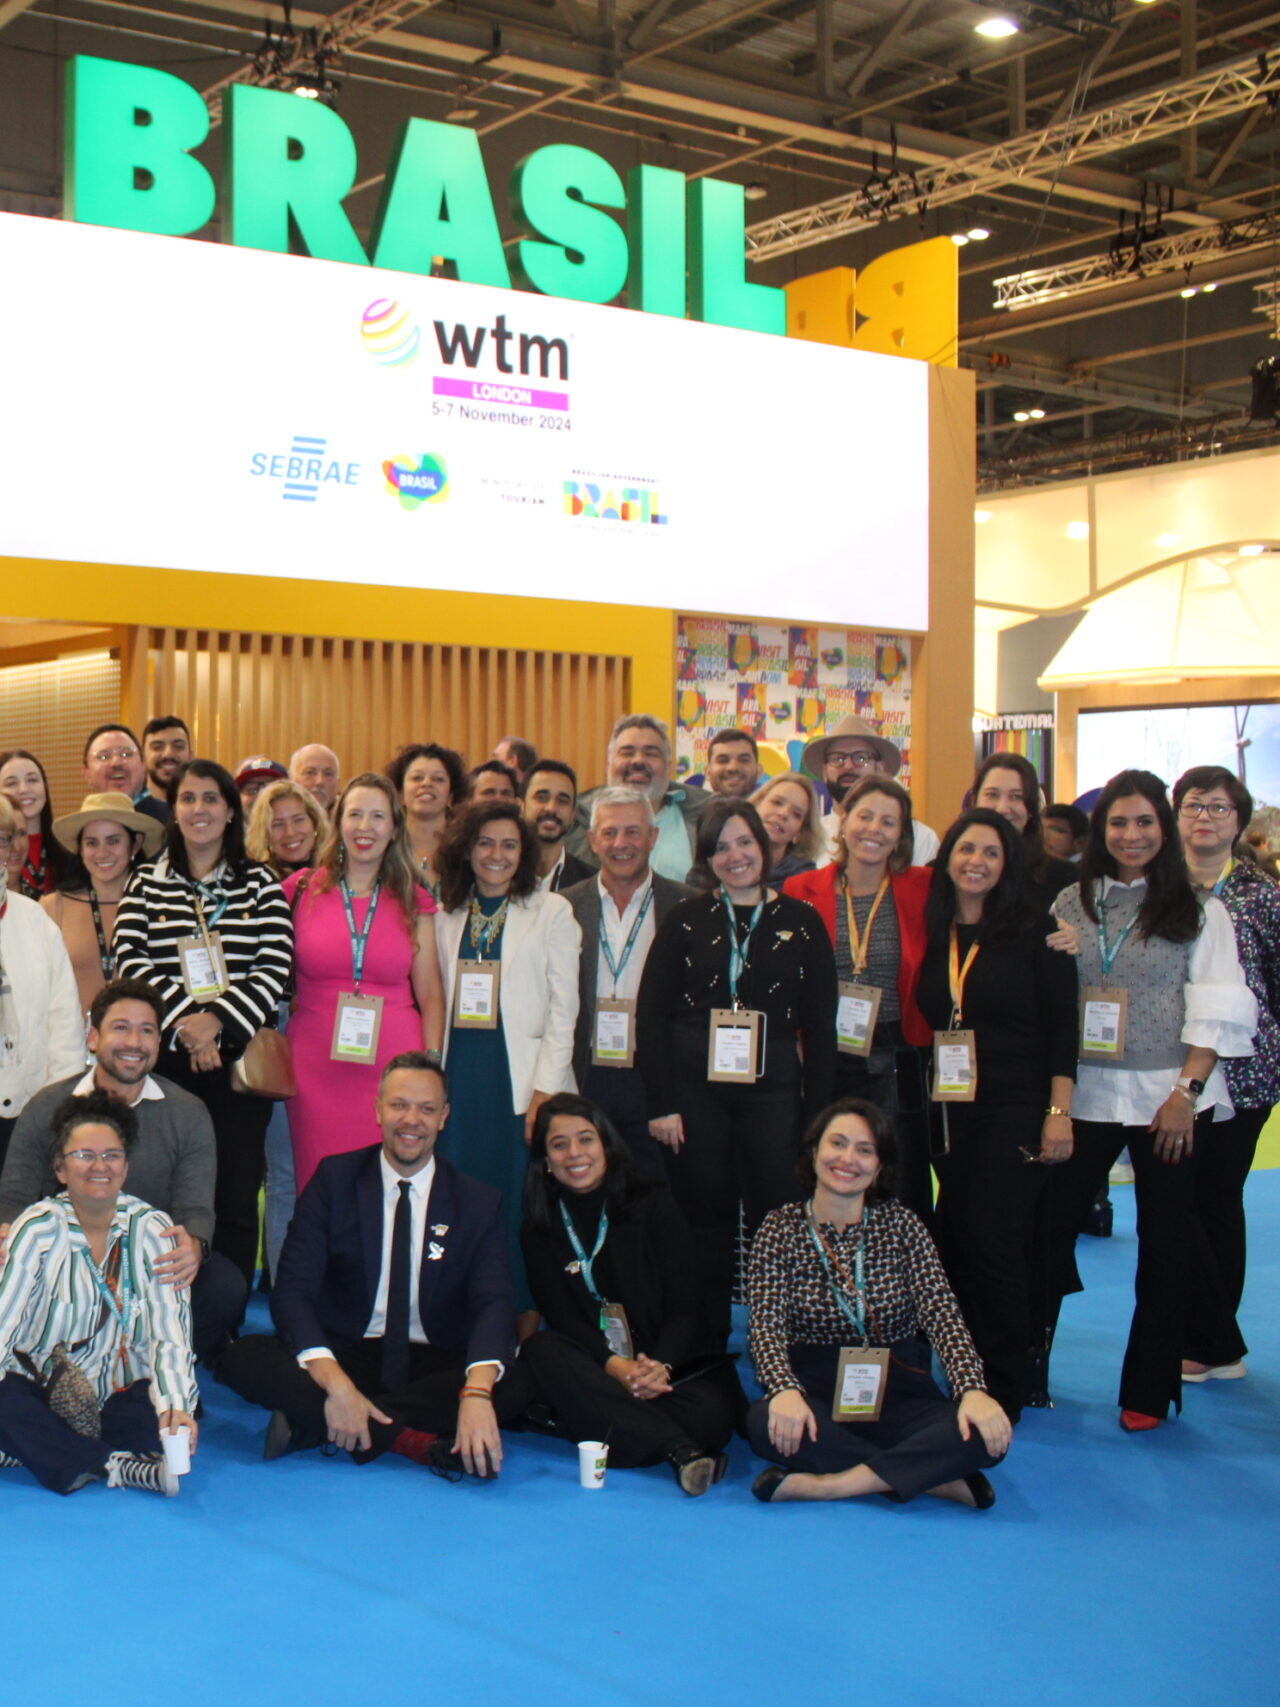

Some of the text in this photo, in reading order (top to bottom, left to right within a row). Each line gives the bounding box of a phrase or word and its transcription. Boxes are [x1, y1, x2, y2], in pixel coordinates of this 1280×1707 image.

[65, 54, 787, 338] BRASIL
[433, 314, 569, 381] wtm
[473, 383, 532, 405] LONDON
[432, 401, 572, 432] 5-7 November 2024
[250, 452, 361, 486] SEBRAE
[400, 474, 437, 490] BRASIL
[563, 480, 669, 525] BRASIL
